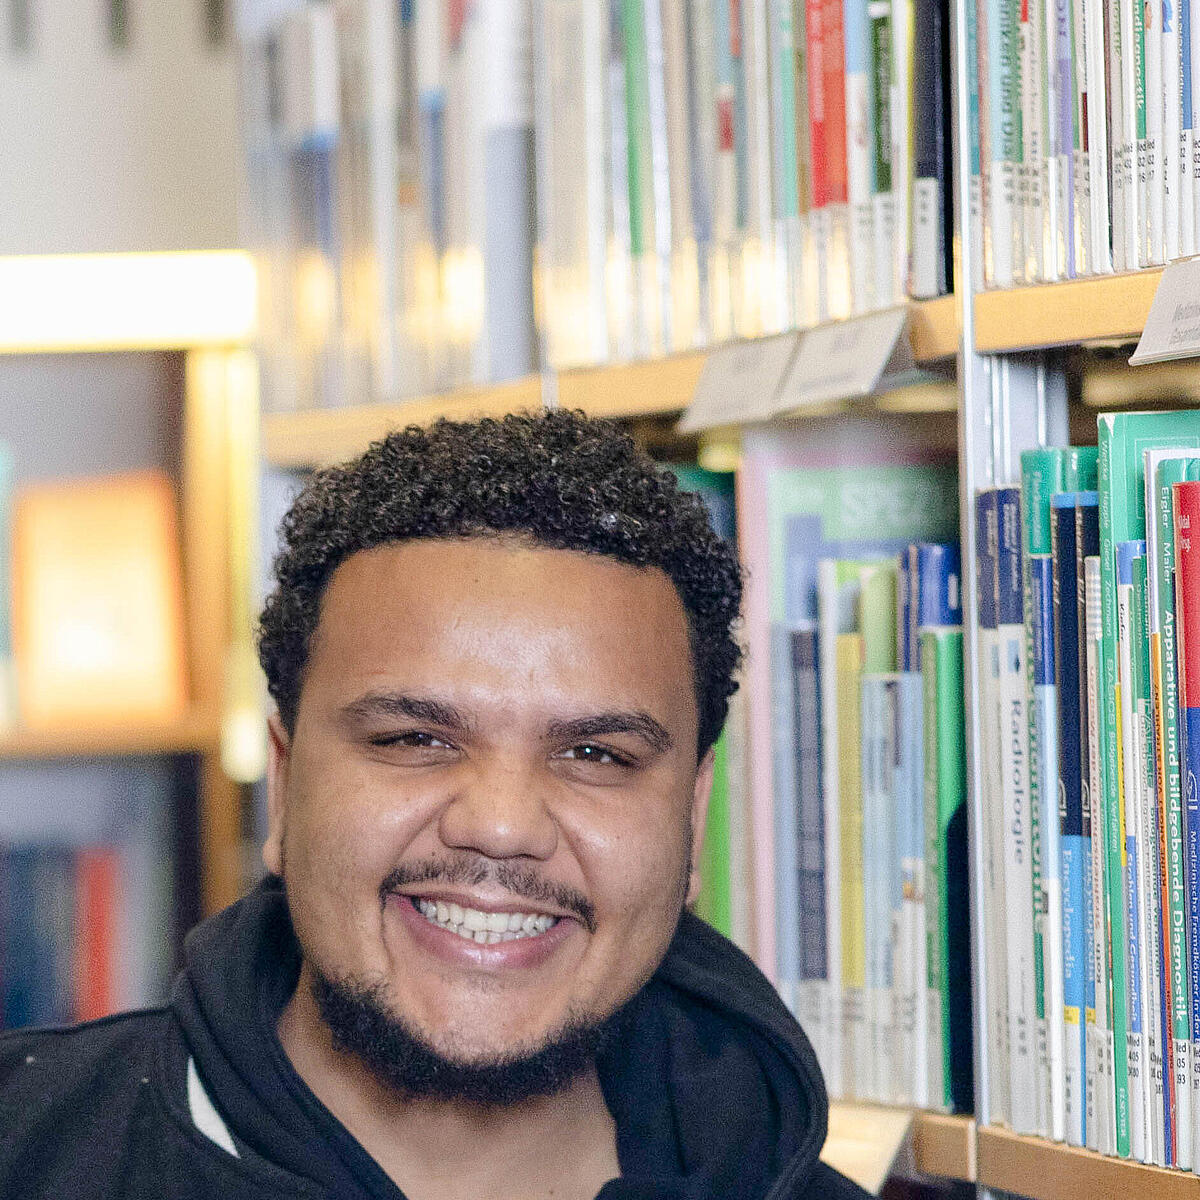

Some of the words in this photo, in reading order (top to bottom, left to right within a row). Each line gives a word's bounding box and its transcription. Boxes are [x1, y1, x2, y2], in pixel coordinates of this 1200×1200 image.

[1161, 486, 1170, 529] Eigler
[1163, 542, 1172, 585] Maier
[1163, 610, 1177, 720] Apparative
[1011, 700, 1025, 864] Radiologie
[1168, 726, 1179, 766] und
[1168, 773, 1184, 903] bildgebende
[1190, 830, 1198, 912] Medizinische
[1063, 850, 1076, 979] Encyclopedia
[1191, 915, 1200, 996] Fremdkörper
[1172, 910, 1187, 1022] Diagnostik
